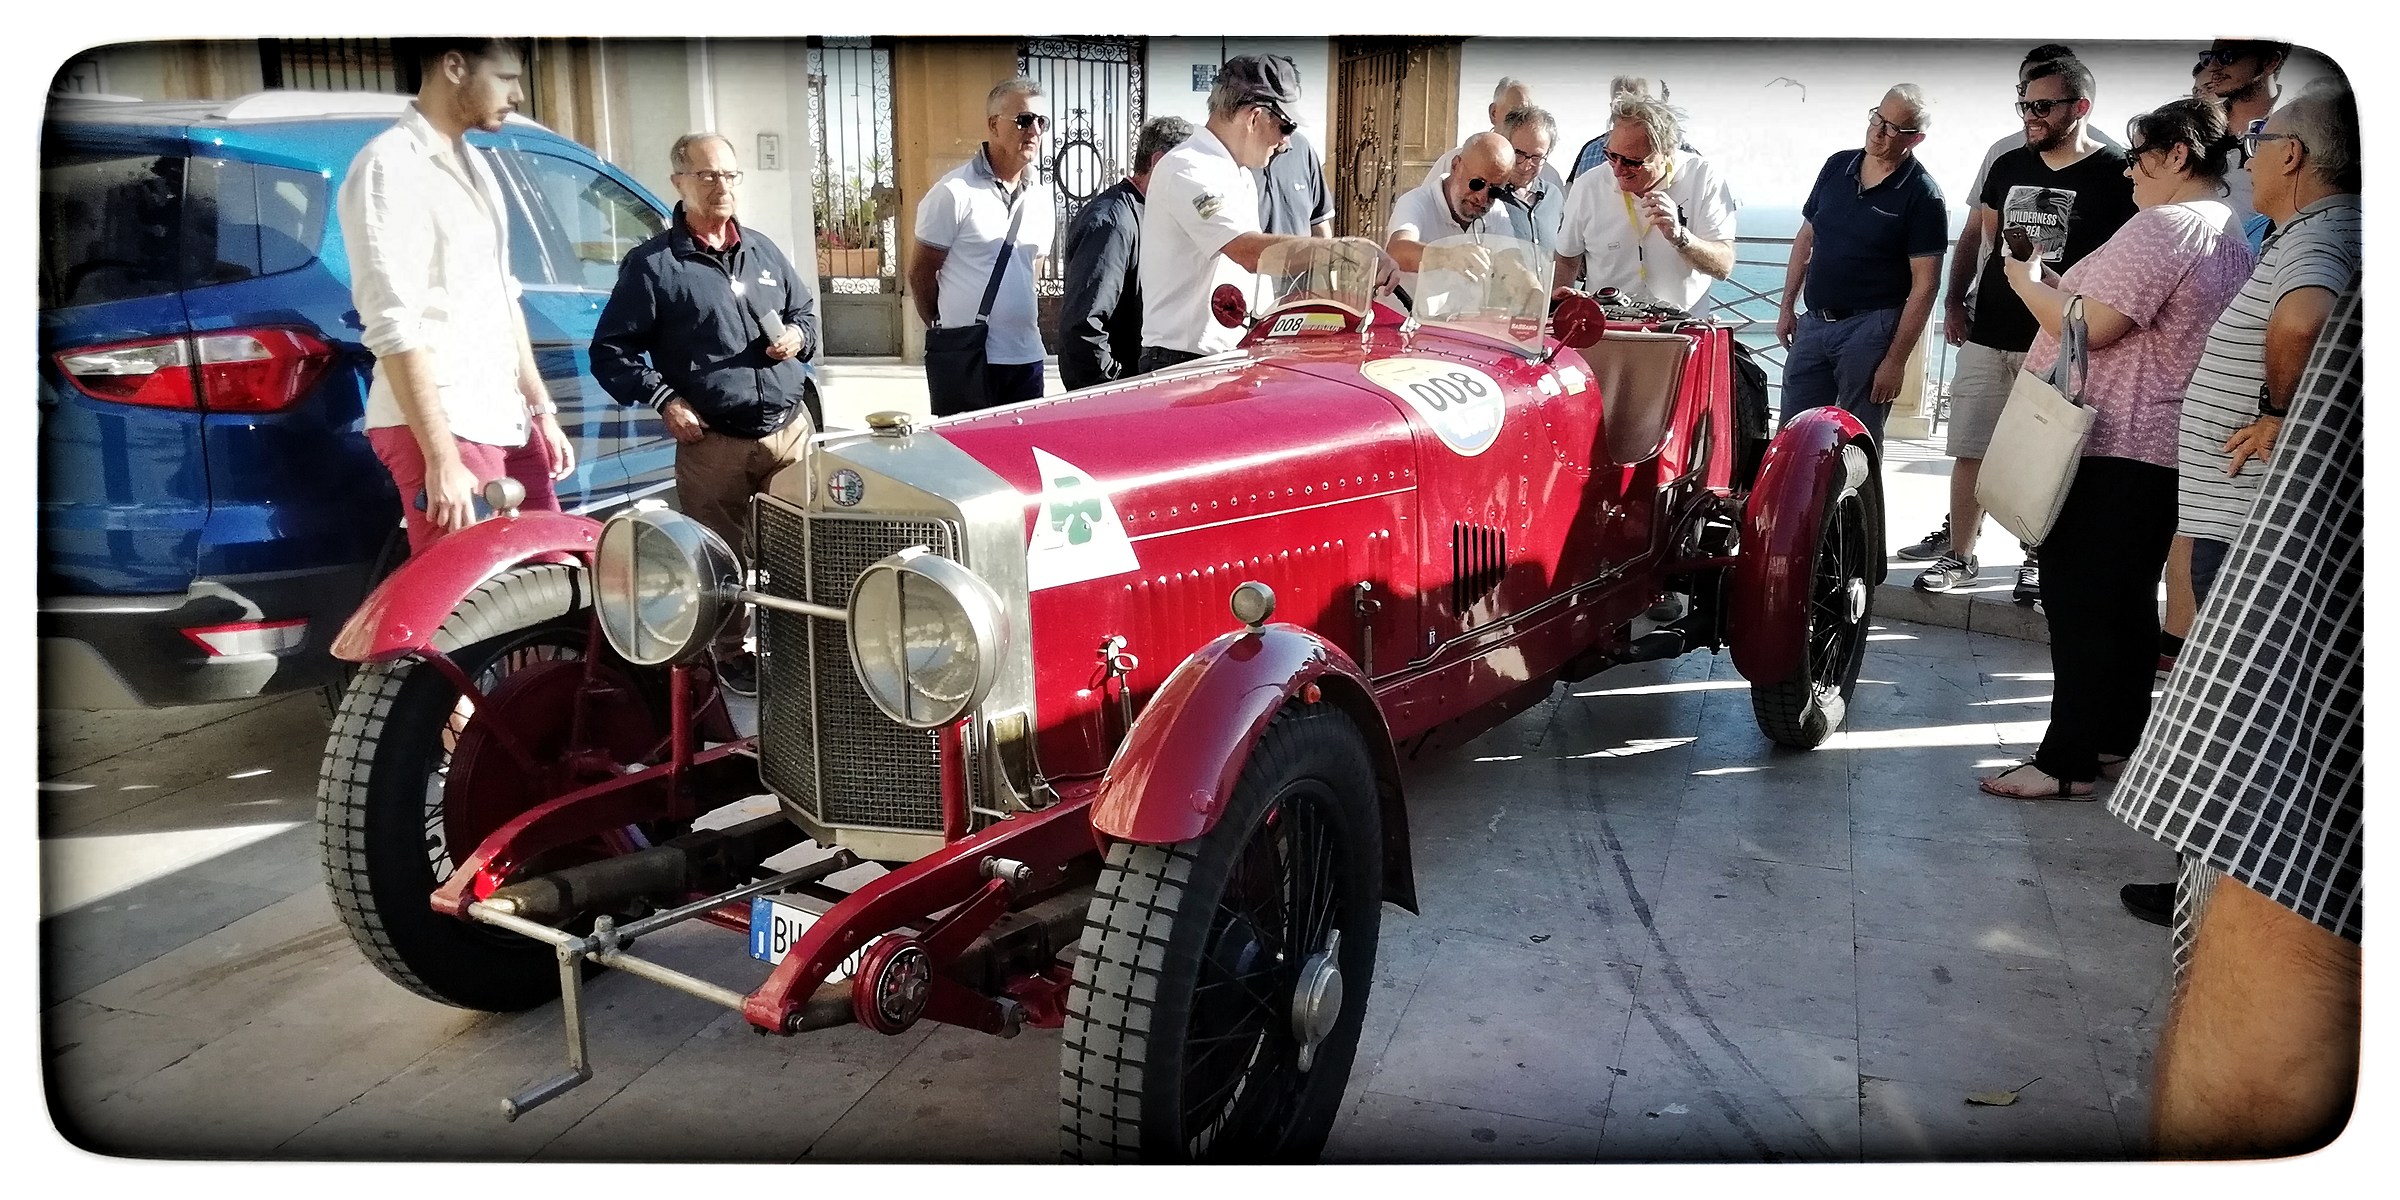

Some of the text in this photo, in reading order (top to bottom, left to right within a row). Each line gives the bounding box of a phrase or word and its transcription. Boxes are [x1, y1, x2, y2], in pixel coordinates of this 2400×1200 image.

[2009, 210, 2057, 226] WILDERNESS
[2024, 225, 2041, 237] REA
[1273, 317, 1304, 333] 008
[1408, 372, 1488, 412] 008
